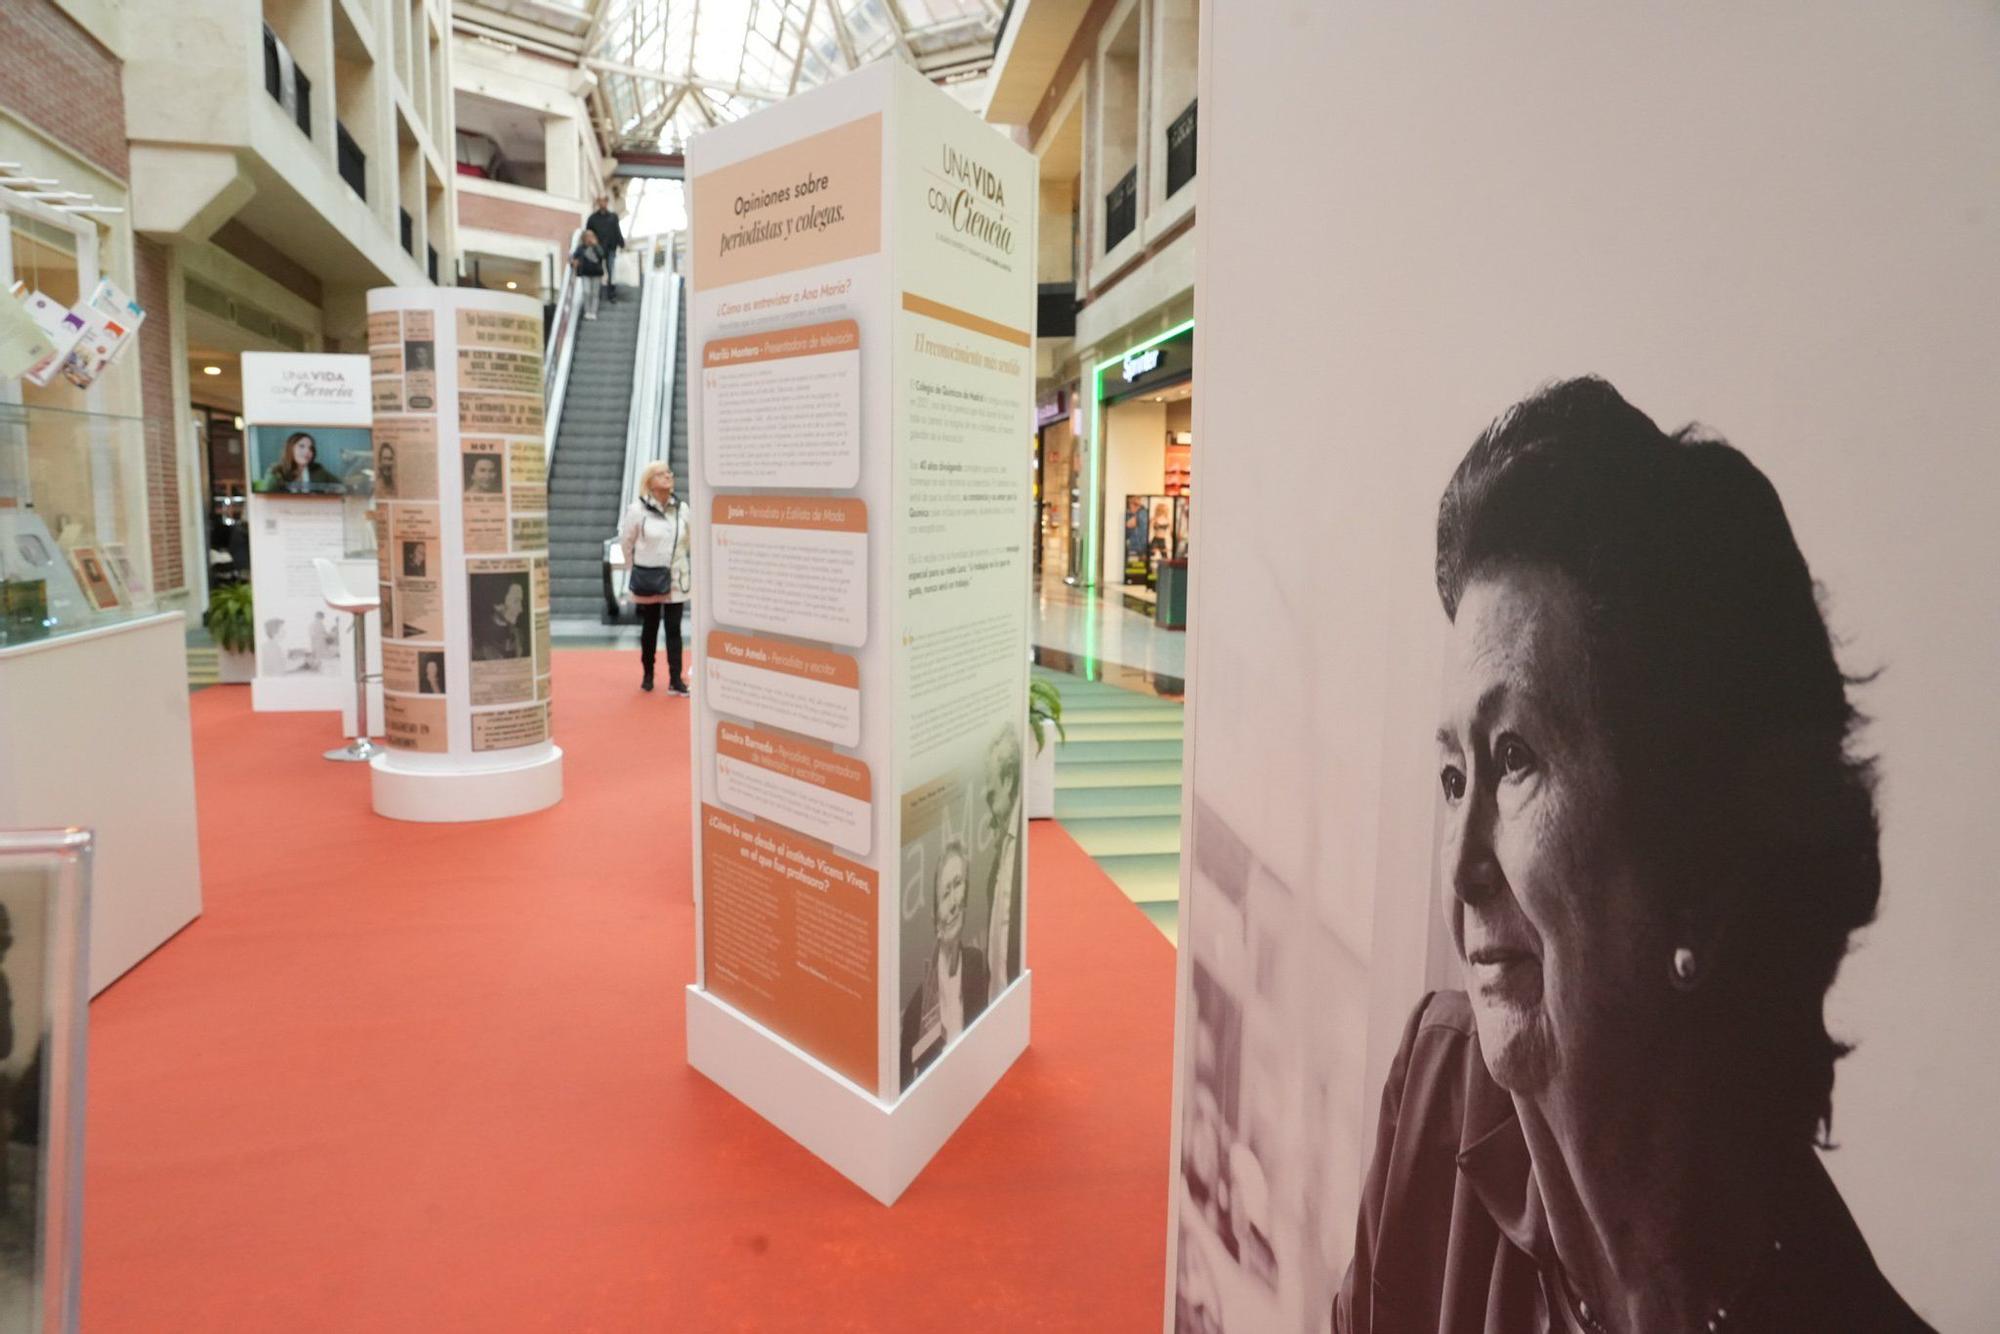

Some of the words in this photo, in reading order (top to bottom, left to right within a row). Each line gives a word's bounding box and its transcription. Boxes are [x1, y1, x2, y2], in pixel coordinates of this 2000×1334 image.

[943, 143, 970, 186] UNA
[972, 163, 1005, 206] VIDA
[734, 186, 790, 217] Opiniones
[795, 173, 828, 198] sobre
[719, 216, 784, 256] periodistas
[784, 219, 793, 241] y
[796, 202, 845, 232] colegas.
[928, 187, 951, 216] CON
[952, 189, 1015, 255] Ciencia
[801, 288, 818, 301] Ana
[914, 333, 925, 352] El
[283, 371, 309, 380] UNA
[311, 371, 344, 382] VIDA
[293, 382, 354, 398] Ciencia
[721, 728, 743, 745] Sandra
[740, 847, 750, 858] en
[750, 848, 758, 861] el
[758, 854, 773, 868] que
[774, 857, 785, 873] fue
[754, 832, 776, 853] desde
[777, 842, 785, 856] el
[786, 845, 816, 868] instituto
[816, 858, 844, 882] Vicens
